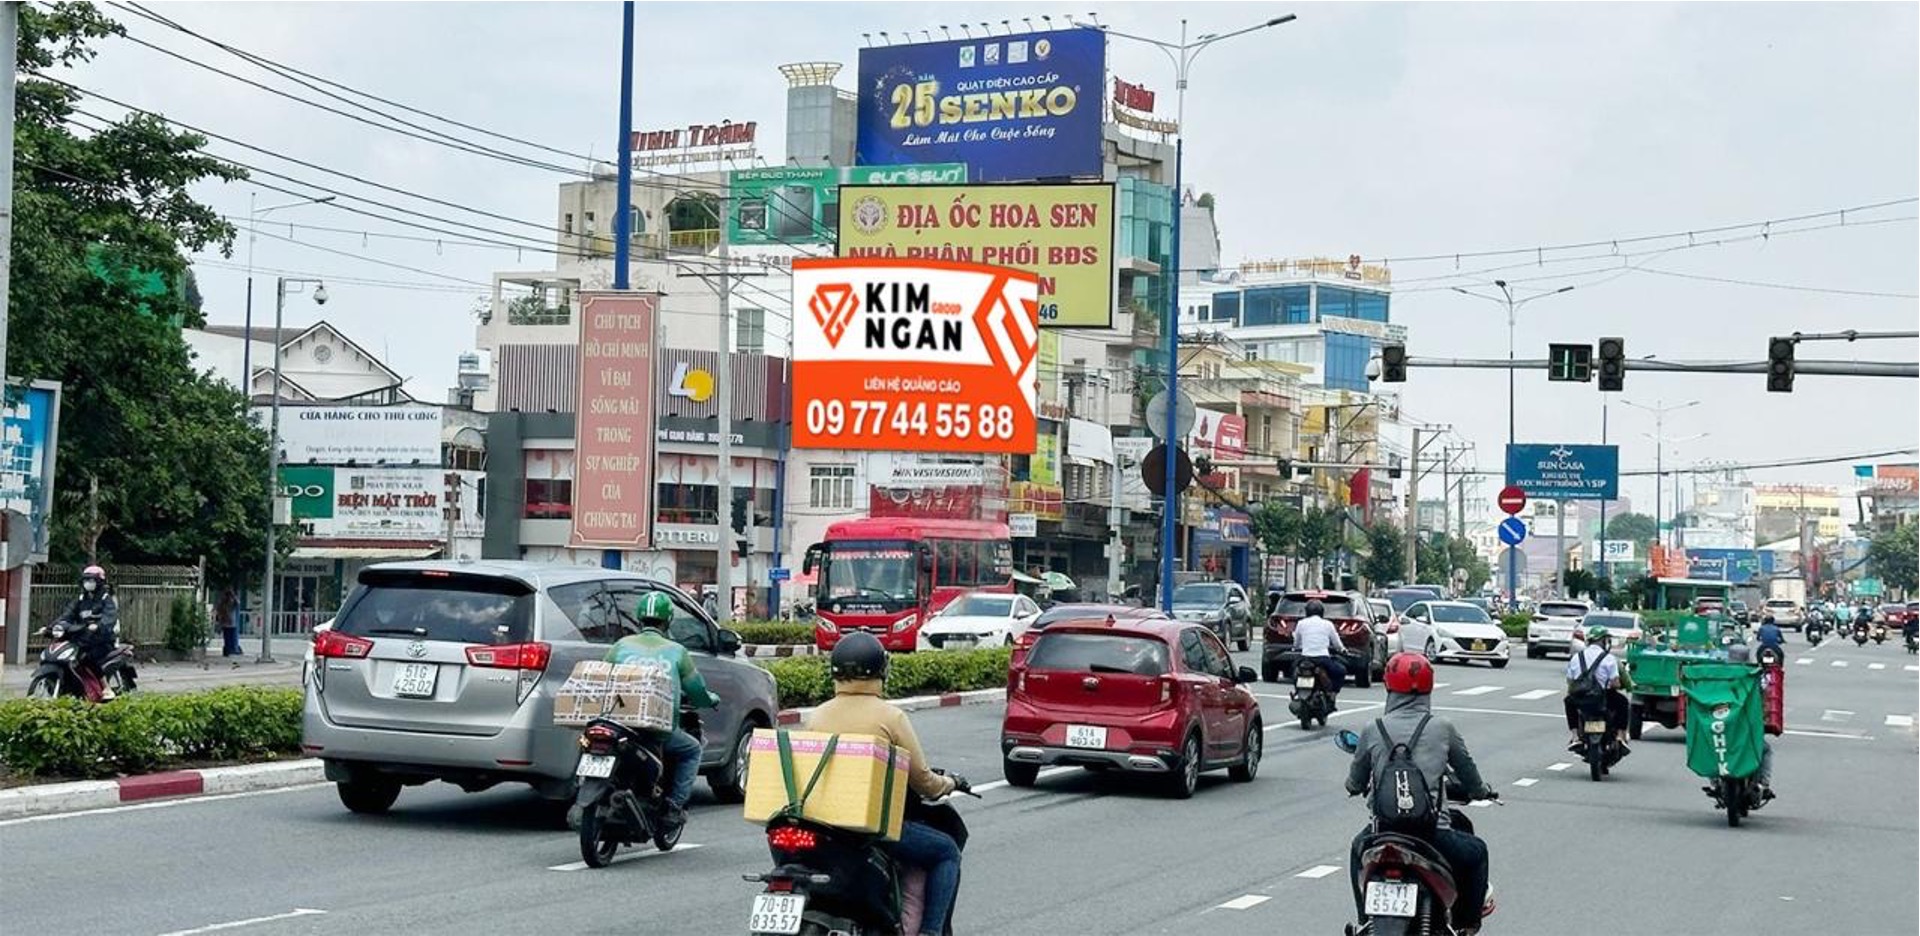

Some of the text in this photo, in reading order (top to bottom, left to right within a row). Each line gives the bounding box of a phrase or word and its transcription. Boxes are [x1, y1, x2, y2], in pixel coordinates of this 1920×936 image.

[957, 80, 985, 92] QUẠT
[1013, 75, 1035, 86] CAO
[1036, 72, 1060, 84] CẤP
[889, 82, 940, 129] 25
[938, 85, 1077, 126] SENKO
[688, 119, 757, 147] TRÂM
[902, 129, 932, 147] Làm
[962, 127, 988, 142] Cho
[1022, 124, 1057, 142] Sống
[897, 193, 1098, 236] ĐỊA ỐC HOA SEN
[907, 243, 974, 262] PHÂN
[982, 240, 1040, 266] PHỐI
[1048, 246, 1098, 266] BĐS
[865, 283, 962, 315] KIM GROUP
[594, 310, 641, 334] CHỦ TỊCH
[865, 318, 962, 352] NGAN
[585, 338, 648, 358] HỒ CHÍ MINH
[613, 371, 632, 390] ĐẠI
[864, 376, 961, 393] LIÊN HỆ QUẢNG CÁO
[590, 394, 639, 415] SỐNG MÃI
[357, 411, 381, 421] CHO
[806, 398, 845, 435] 09
[850, 400, 888, 435] 77
[891, 401, 928, 436] 44
[935, 404, 971, 438] 55
[978, 405, 1014, 439] 88
[596, 426, 632, 443] TRONG
[585, 453, 641, 477] SỰ NGHIỆP
[1537, 461, 1585, 470] SUN CASA
[602, 480, 621, 500] CỦA
[338, 491, 437, 511] ĐIỆN MẶT TRỜI
[584, 507, 637, 529] CHÚNG TA!
[406, 664, 429, 679] 51G
[1373, 899, 1408, 914] 5542
[751, 914, 798, 931] 835.57
